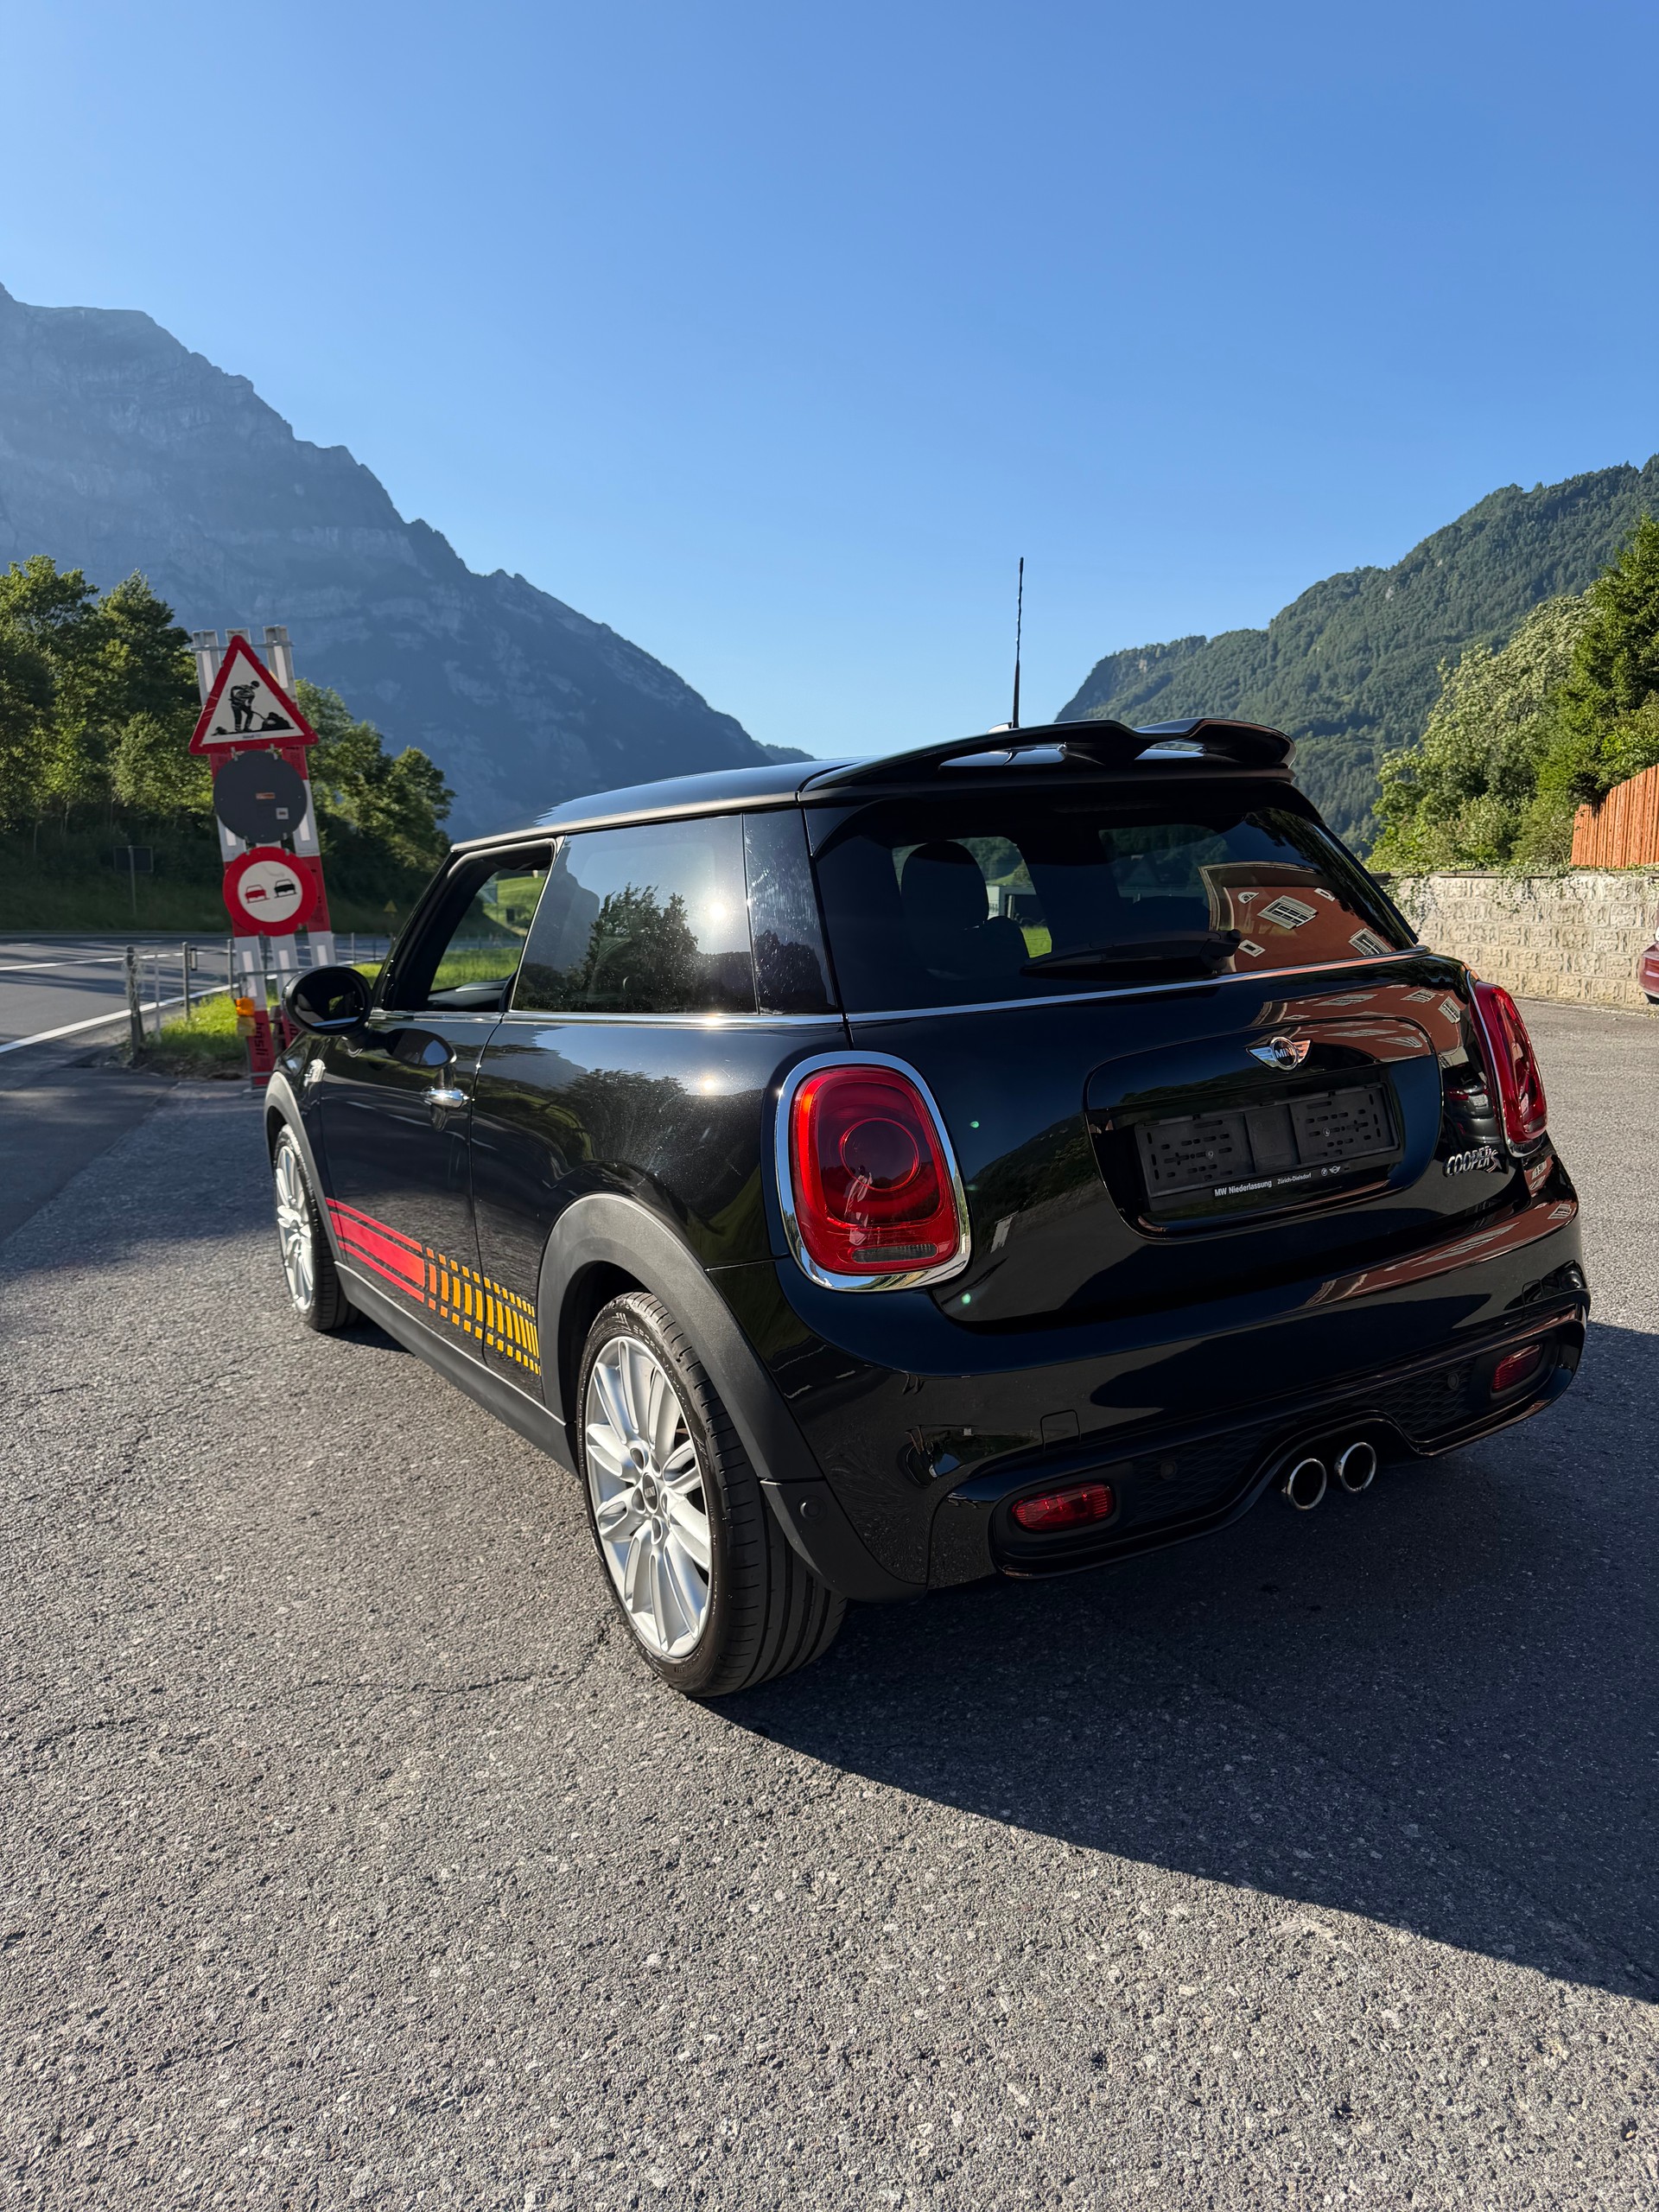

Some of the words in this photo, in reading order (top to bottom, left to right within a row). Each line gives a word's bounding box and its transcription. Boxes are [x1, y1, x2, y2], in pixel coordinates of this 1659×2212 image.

[1274, 1047, 1295, 1058] MINI
[1446, 1145, 1492, 1175] COOPER
[1484, 1149, 1500, 1173] S
[1228, 1180, 1272, 1194] Niederlassung
